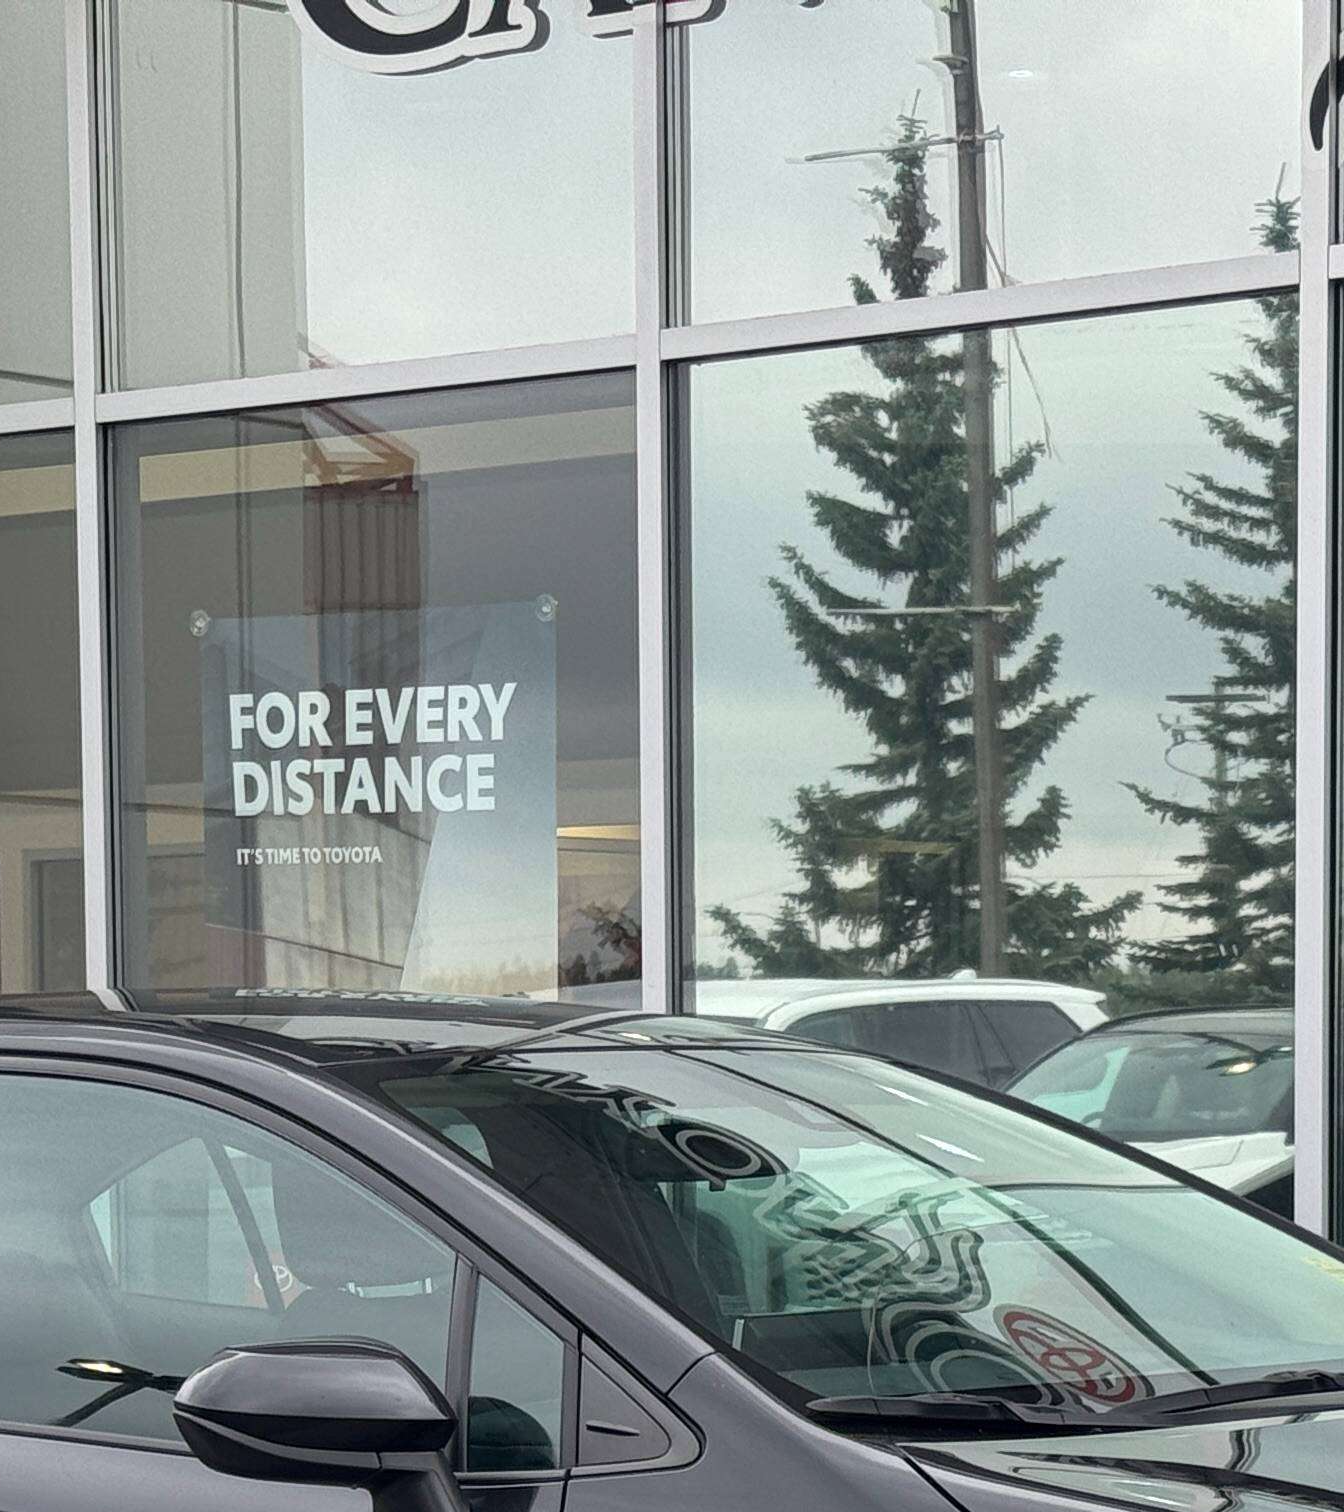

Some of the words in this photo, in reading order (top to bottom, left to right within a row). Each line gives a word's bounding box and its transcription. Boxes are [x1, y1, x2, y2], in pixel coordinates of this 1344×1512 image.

[229, 690, 333, 750] FOR
[345, 682, 518, 746] EVERY
[232, 753, 496, 817] DISTANCE
[236, 847, 264, 866] IT'S
[264, 847, 301, 865] TIME
[301, 847, 322, 864] TO
[322, 845, 384, 864] TOYOTA
